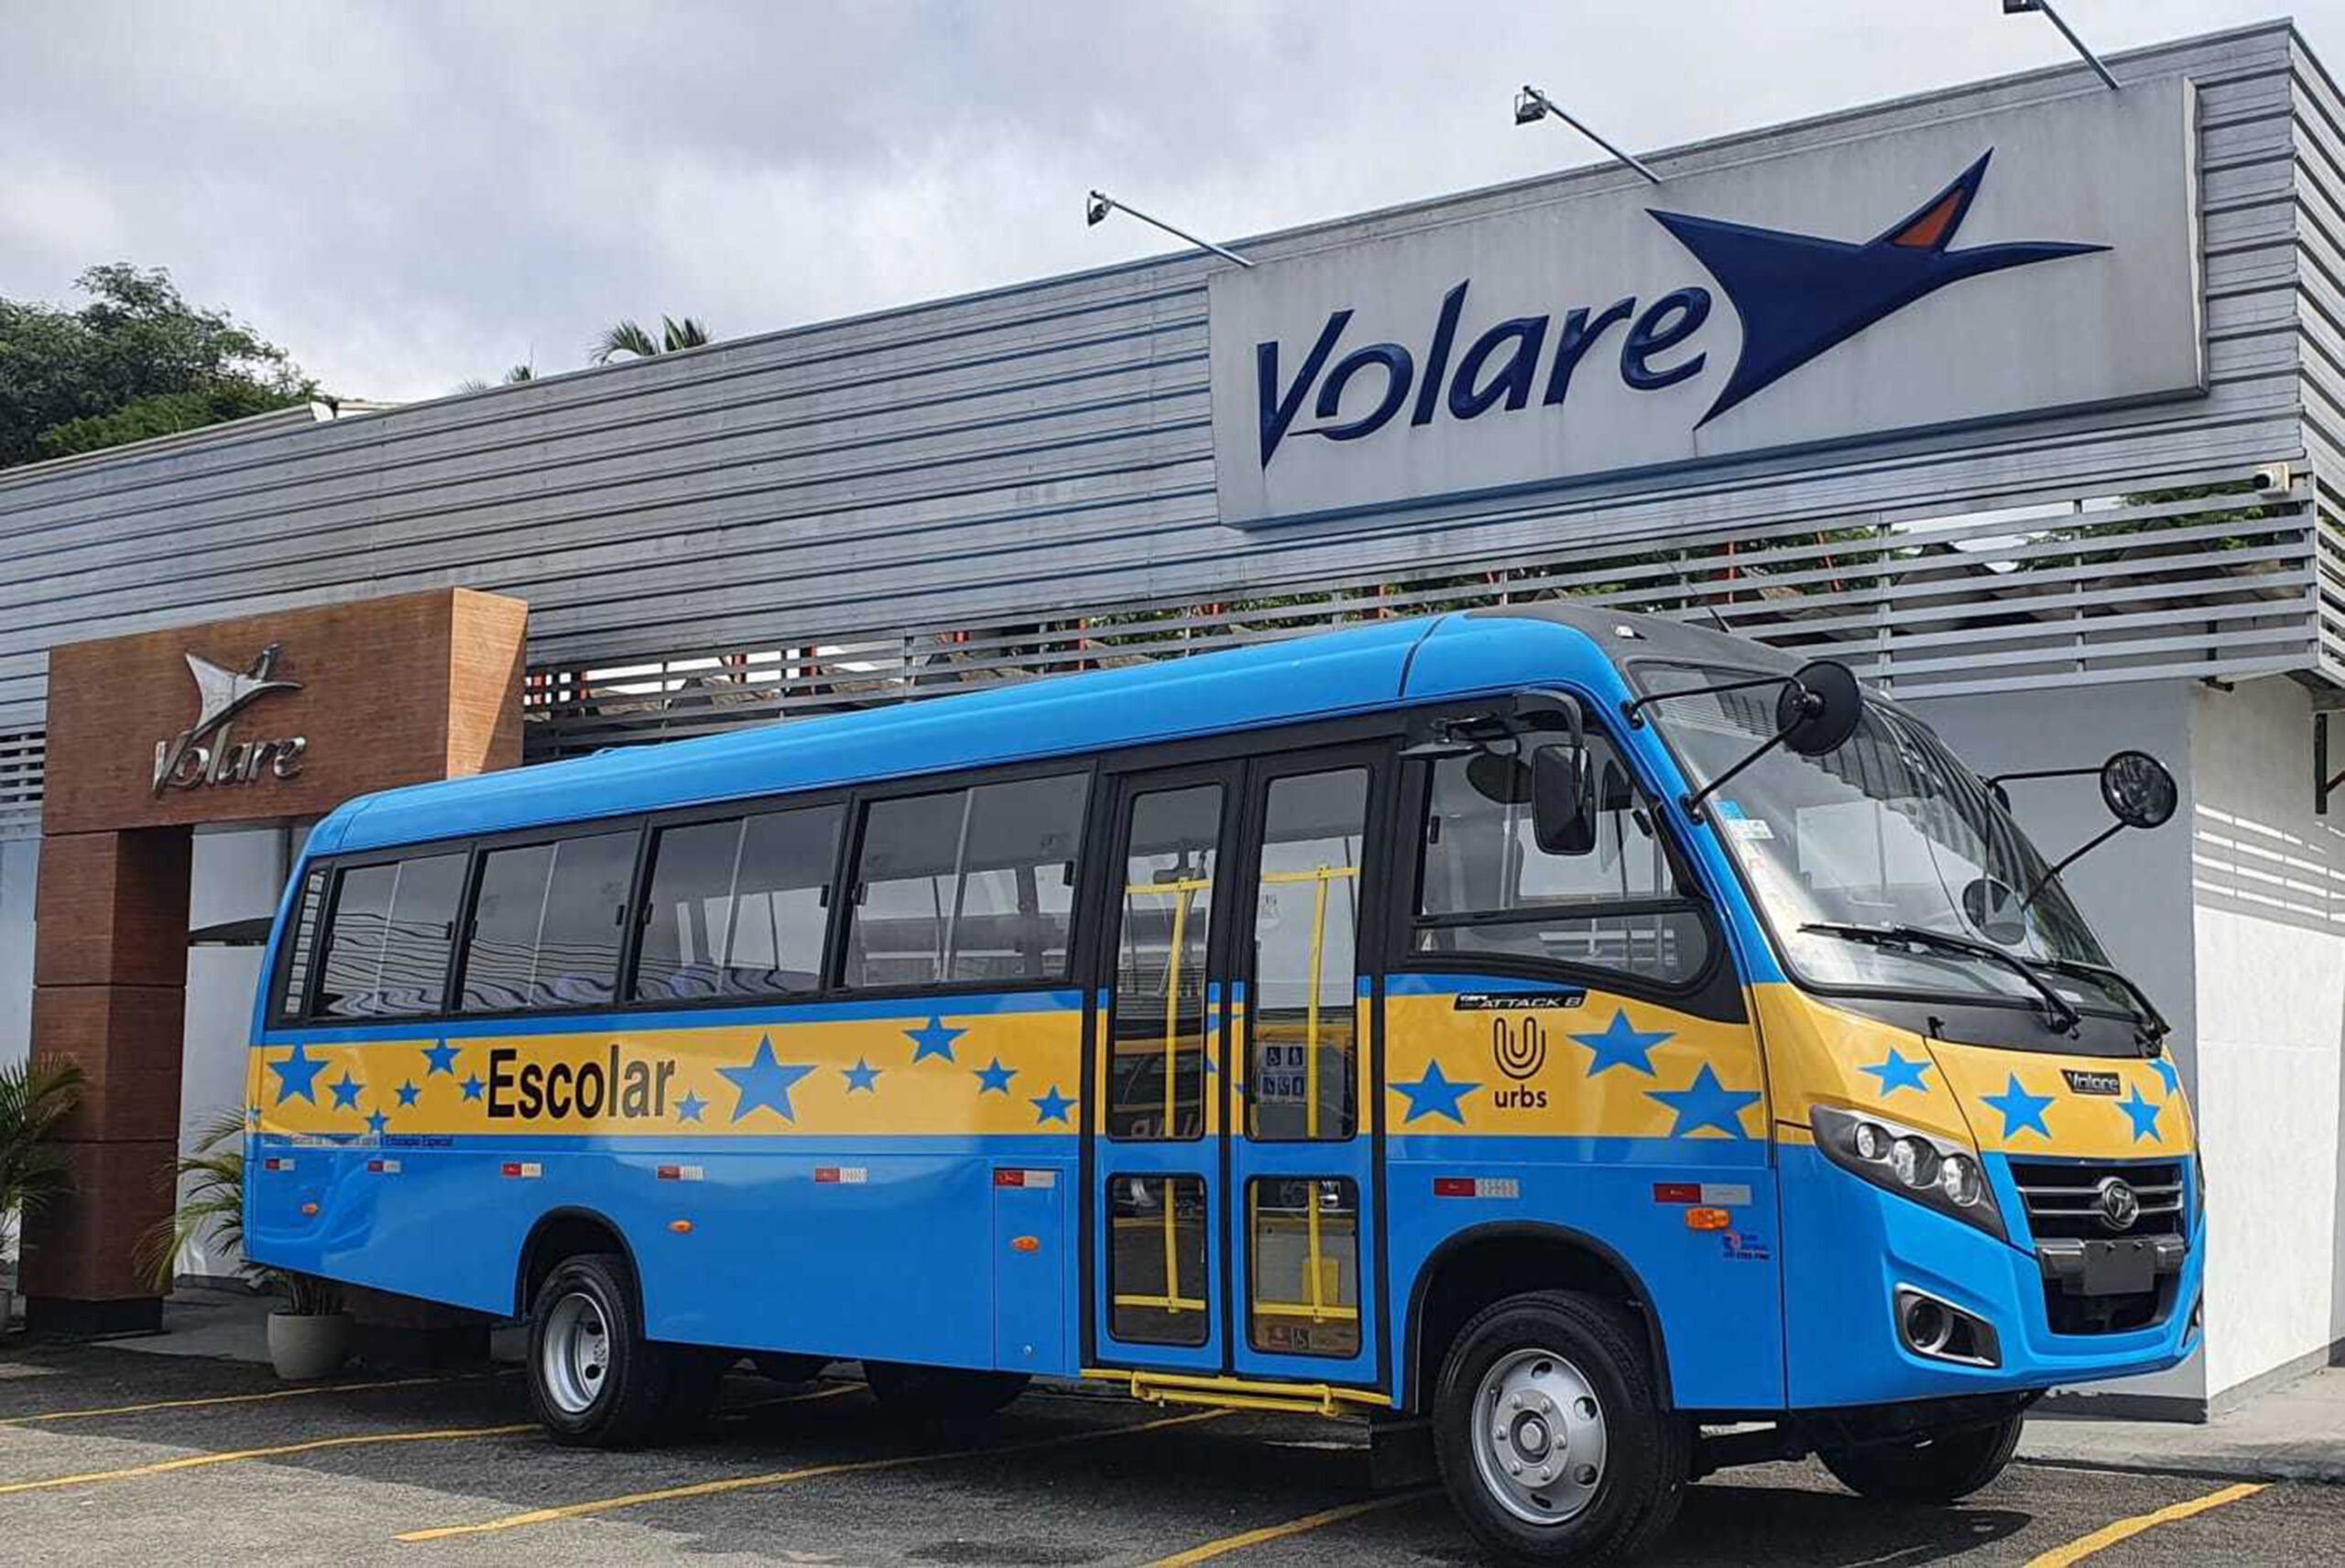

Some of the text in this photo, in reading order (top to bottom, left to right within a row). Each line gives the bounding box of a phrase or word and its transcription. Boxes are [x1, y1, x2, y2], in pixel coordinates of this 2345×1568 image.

[1256, 278, 1712, 472] Volare
[152, 721, 307, 800] Volare
[1478, 996, 1560, 1008] ATTACK
[1565, 996, 1582, 1007] 8
[487, 1044, 676, 1119] Escolar
[1494, 1083, 1547, 1109] urbs
